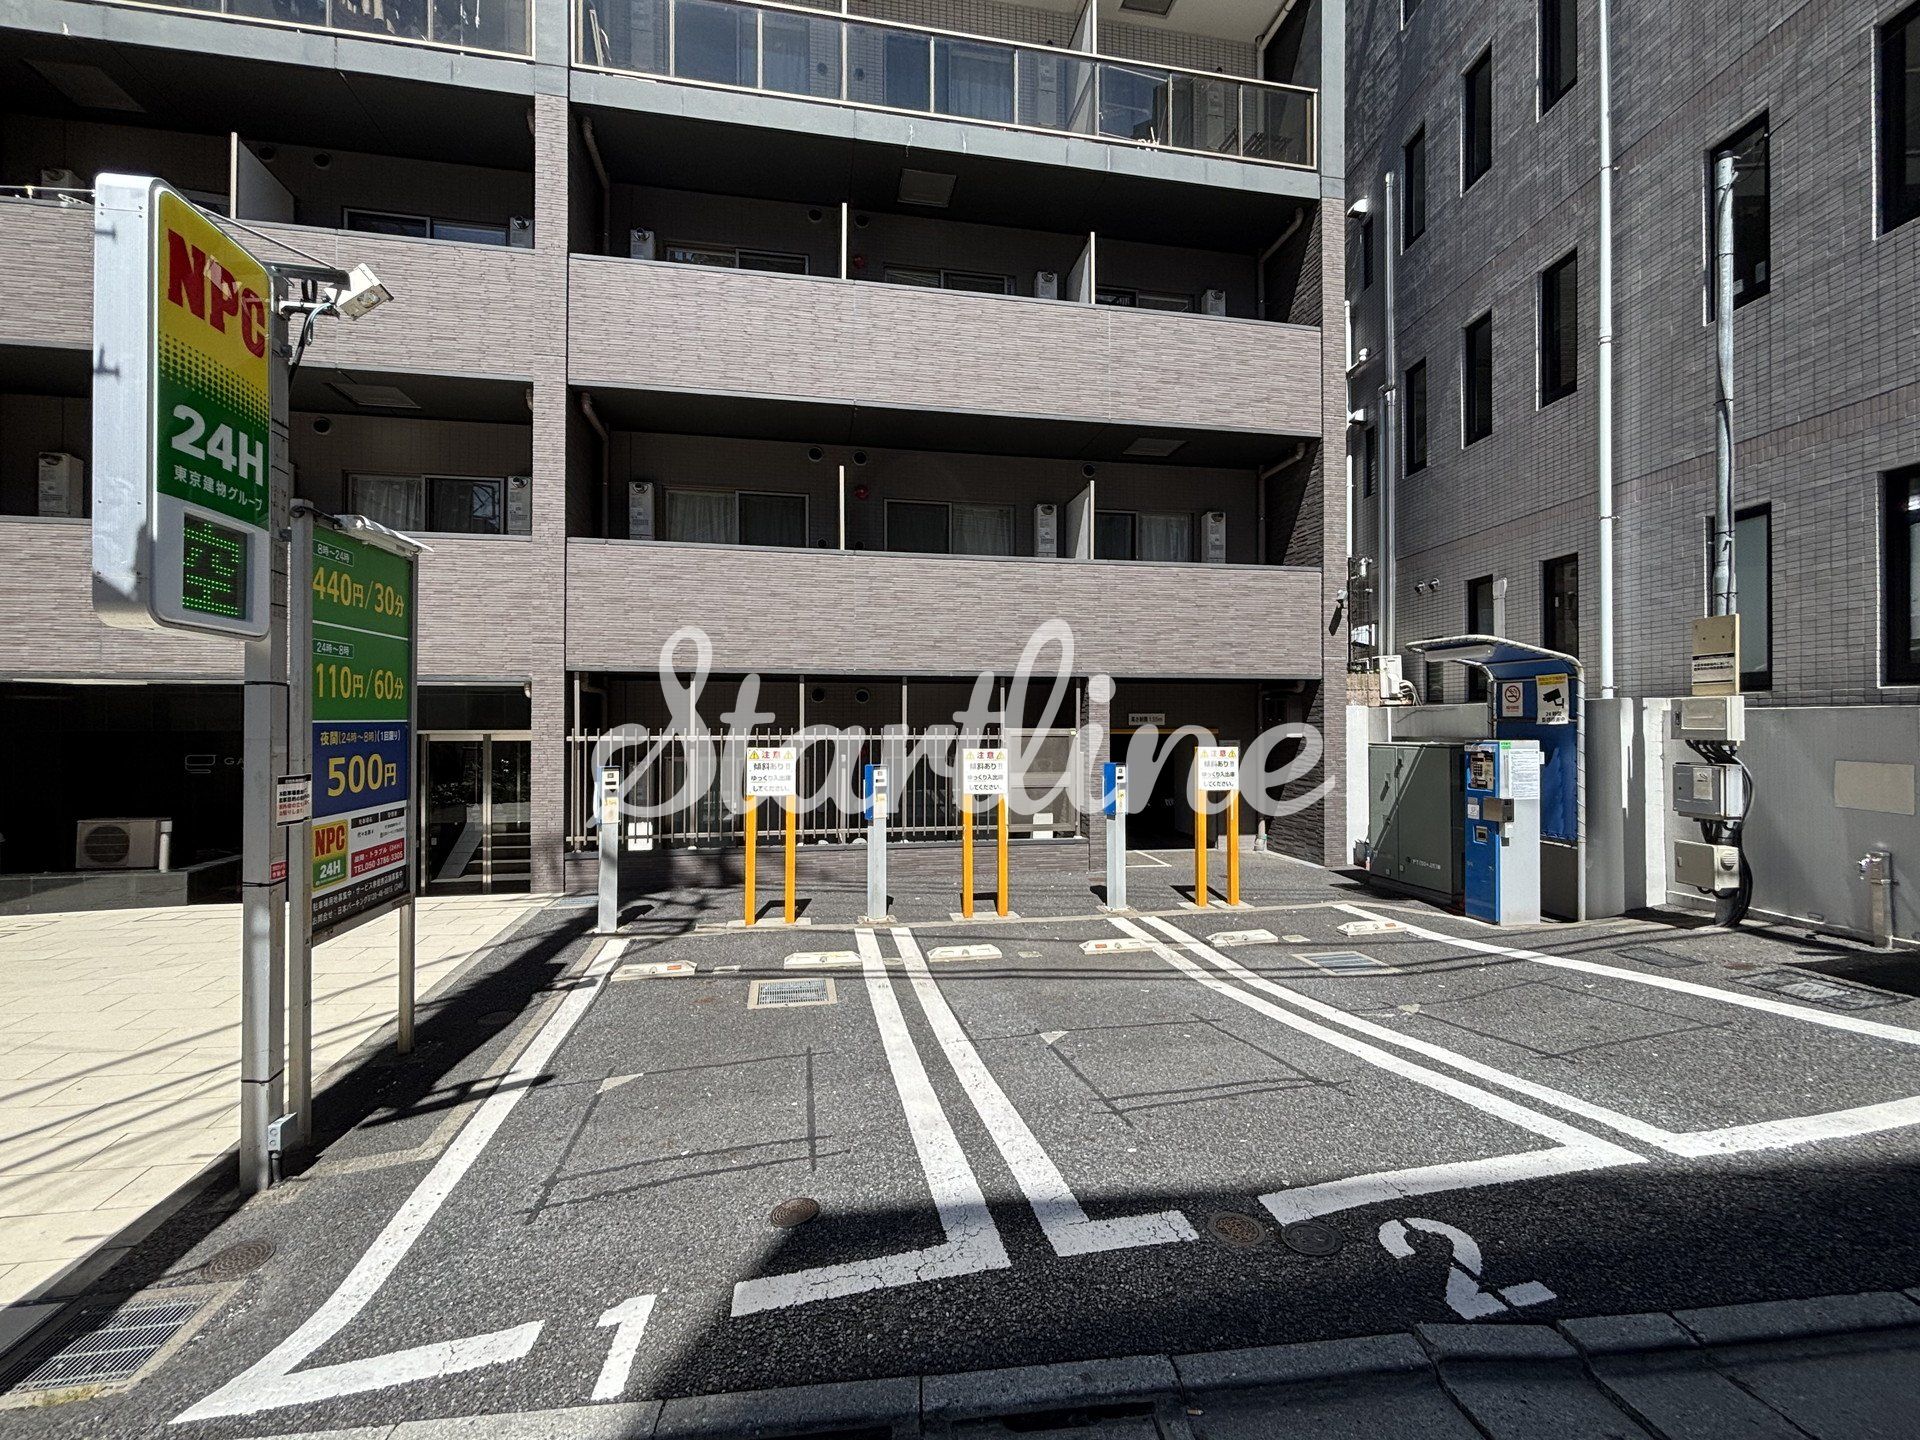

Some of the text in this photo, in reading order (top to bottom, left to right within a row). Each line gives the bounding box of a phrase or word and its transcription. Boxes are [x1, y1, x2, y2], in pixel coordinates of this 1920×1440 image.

[168, 228, 265, 358] NPC
[172, 404, 263, 487] 24H
[174, 465, 263, 511] 東京建物グループ
[182, 520, 240, 616] 空
[312, 566, 404, 618] 440円/30分
[316, 663, 404, 700] 110円/60分
[327, 753, 397, 797] 500円
[314, 825, 345, 857] NPC
[319, 859, 341, 879] 24H
[1378, 1217, 1557, 1320] 2
[591, 1294, 658, 1401] 1
